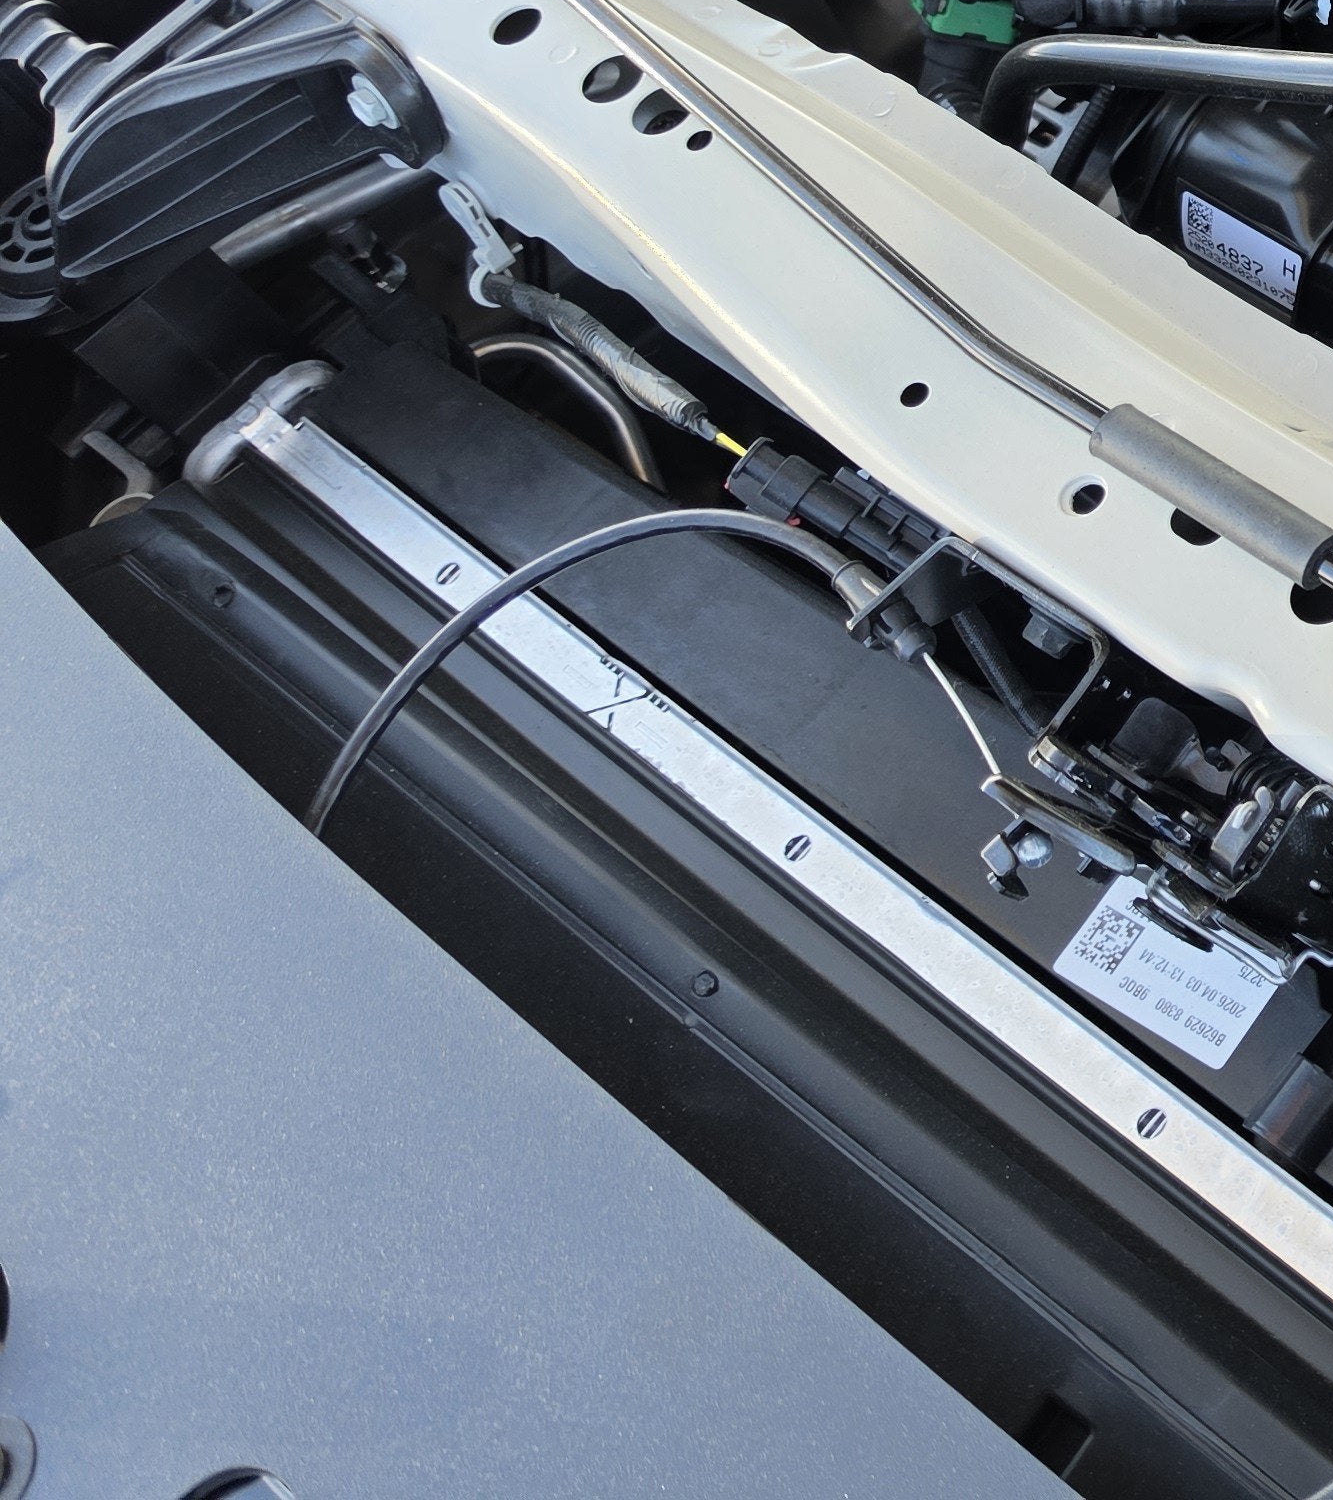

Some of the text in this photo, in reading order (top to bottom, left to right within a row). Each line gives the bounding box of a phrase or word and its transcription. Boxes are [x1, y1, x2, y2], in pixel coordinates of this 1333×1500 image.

[1283, 258, 1296, 282] H
[1137, 947, 1247, 1019] 2026.04.03 13:12:44
[1237, 965, 1266, 988] 3275
[1155, 997, 1184, 1022] 8380
[1184, 1014, 1227, 1048] B62629
